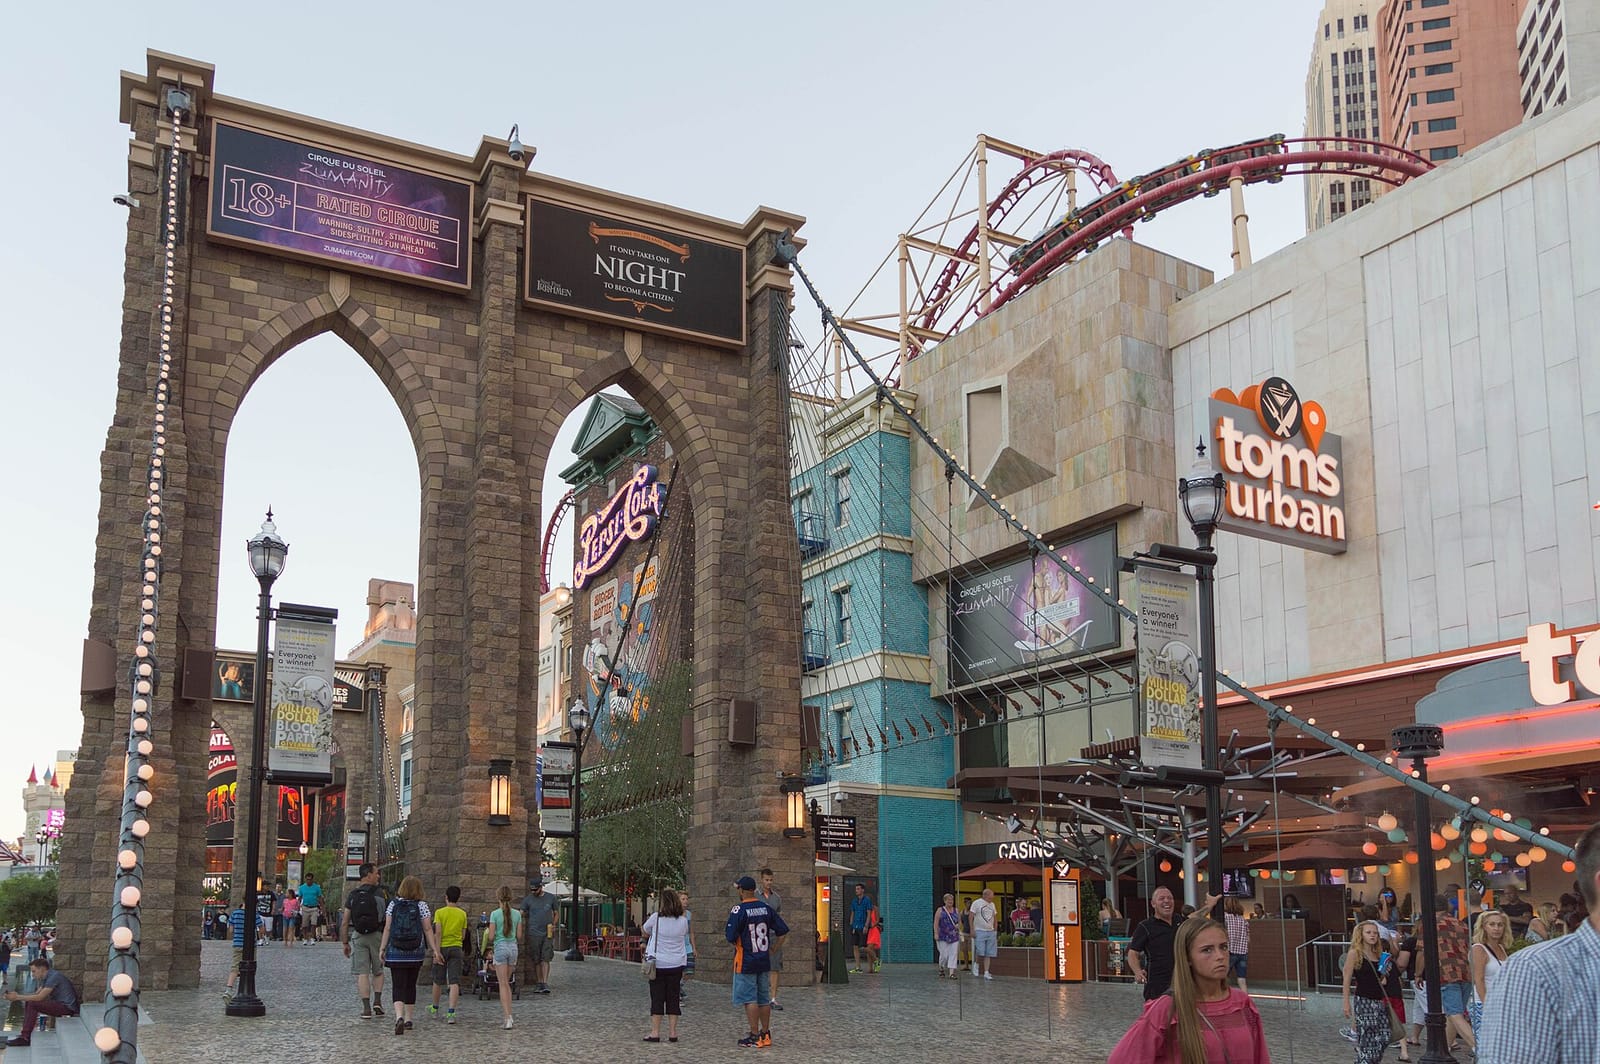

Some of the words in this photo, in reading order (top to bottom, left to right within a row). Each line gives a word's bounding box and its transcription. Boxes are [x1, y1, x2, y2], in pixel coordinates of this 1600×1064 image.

[307, 152, 341, 167] CIRQUE
[342, 160, 355, 170] DU
[356, 164, 387, 178] SOLEIL
[316, 193, 372, 219] RATED
[377, 207, 440, 234] CIRQUE
[330, 228, 383, 246] SIDESPLITTING
[385, 241, 400, 250] FUN
[323, 245, 374, 261] ZUMANITY.COM
[609, 244, 617, 252] IT
[617, 246, 636, 256] ONLY
[637, 250, 656, 261] TAKES
[655, 255, 671, 265] ONE
[593, 253, 687, 293] NIGHT
[603, 281, 614, 289] TO
[615, 284, 642, 296] BECOME
[1217, 415, 1340, 498] toms
[1228, 480, 1346, 541] urban
[1142, 606, 1180, 621] Everyone's
[1150, 619, 1177, 630] winner!
[278, 649, 317, 661] Everyone's
[286, 659, 314, 667] winner!
[1146, 676, 1187, 694] MILLION
[1146, 687, 1187, 706] DOLLAR
[277, 711, 319, 725] DOLLAR
[278, 703, 320, 717] MILLION
[1146, 713, 1187, 734] PARTY
[998, 839, 1056, 860] CASINO
[748, 922, 769, 953] 18
